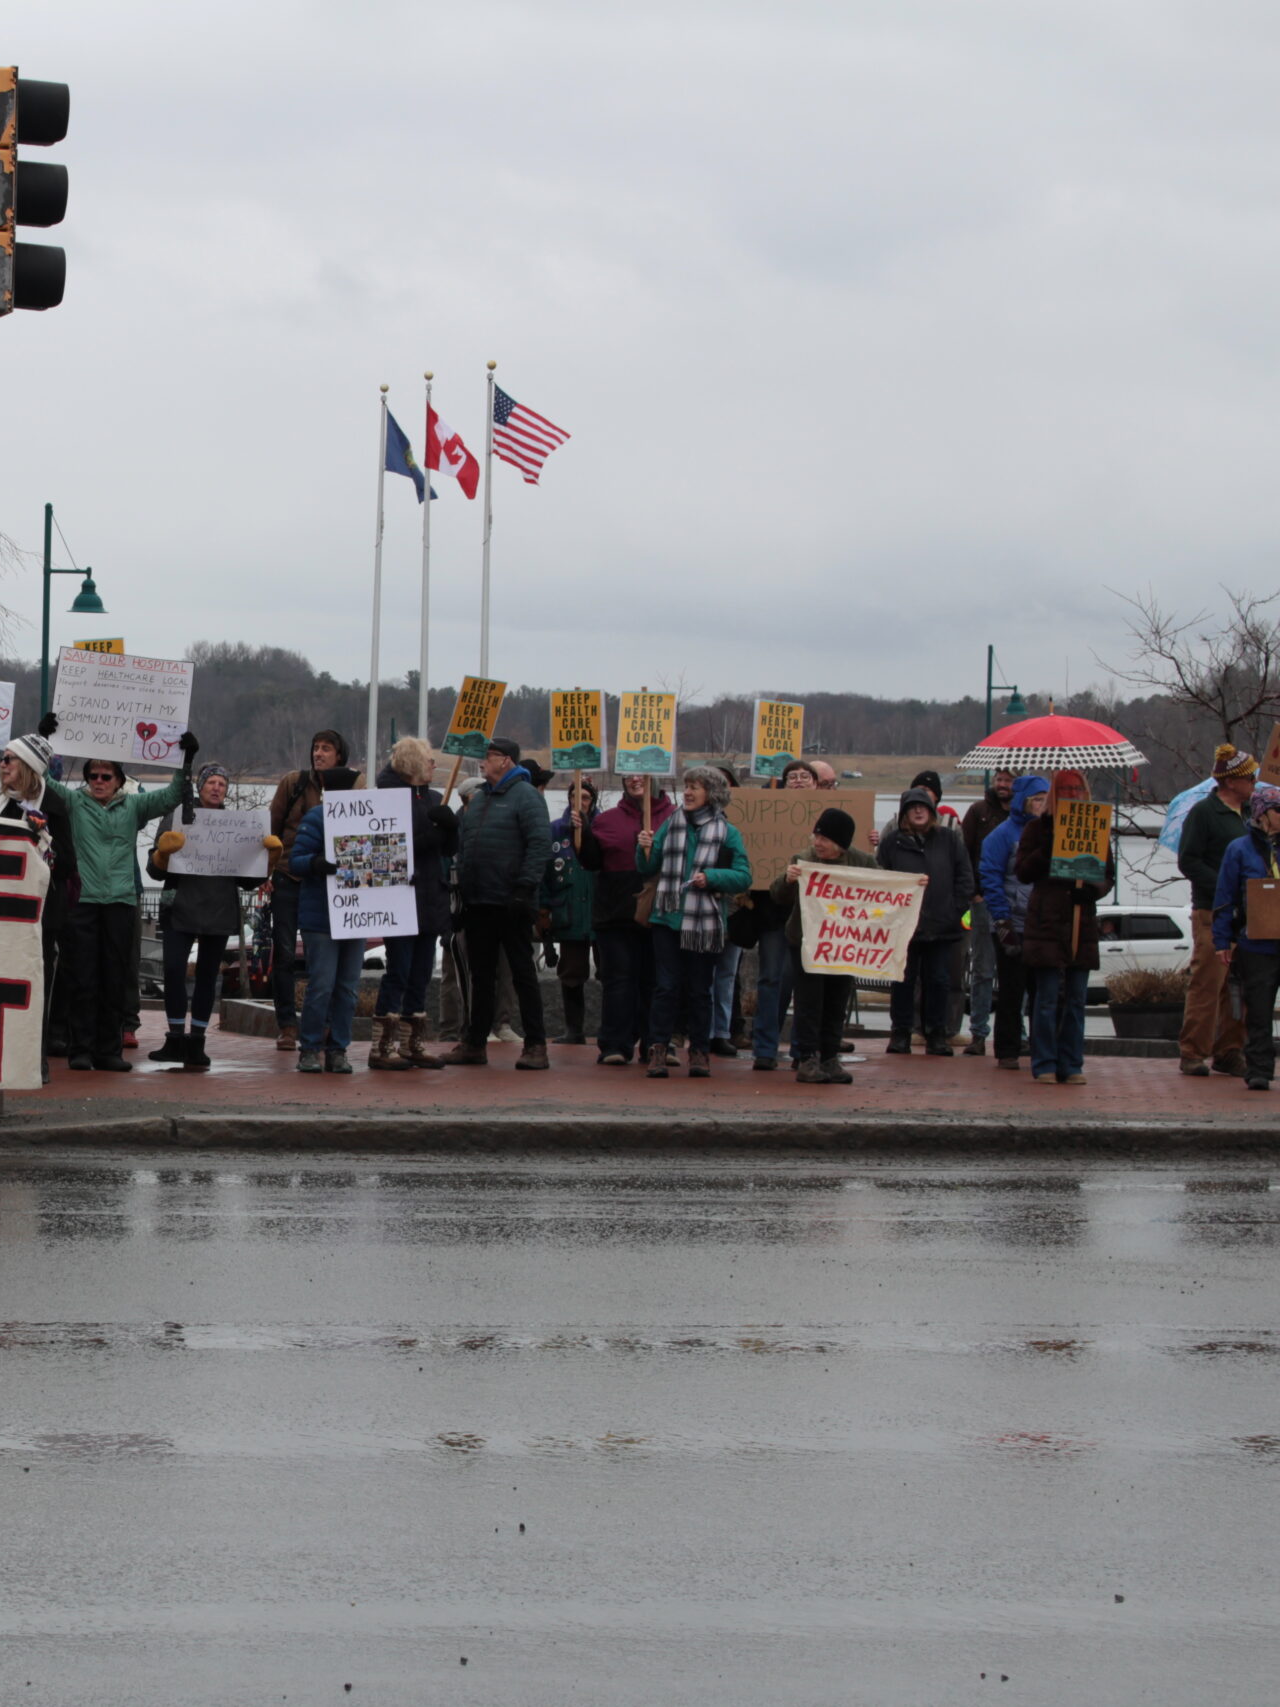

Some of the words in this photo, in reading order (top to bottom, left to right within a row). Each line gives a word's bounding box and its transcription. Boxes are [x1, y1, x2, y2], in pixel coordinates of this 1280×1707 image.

[84, 641, 112, 653] KEEP
[66, 648, 96, 663] SAVE
[99, 654, 126, 666] OUR
[132, 658, 187, 673] HOSPITAL
[62, 664, 87, 675] KEEP
[98, 670, 155, 683] HEALTHCARE
[162, 677, 189, 687] LOCAL
[471, 680, 496, 693] KEEP
[56, 694, 62, 706] I
[68, 696, 110, 710] STAND
[116, 700, 152, 714] WITH
[160, 704, 178, 716] MY
[460, 691, 500, 708] HEALTH
[562, 693, 590, 704] KEEP
[633, 695, 664, 707] KEEP
[464, 706, 490, 719] CARE
[555, 705, 598, 717] HEALTH
[624, 708, 670, 720] HEALTH
[768, 704, 794, 716] KEEP
[456, 716, 488, 732] LOCAL
[562, 718, 591, 729] CARE
[630, 720, 662, 732] CARE
[761, 715, 800, 729] HEALTH
[64, 728, 84, 742] DO
[559, 730, 594, 742] LOCAL
[626, 732, 664, 745] LOCAL
[766, 728, 792, 740] CARE
[763, 738, 794, 753] LOCAL
[326, 800, 374, 819] HANDS
[1070, 802, 1100, 816] KEEP
[202, 814, 246, 827] deserve
[368, 818, 398, 832] OFF
[1060, 814, 1107, 830] HEALTH
[207, 830, 234, 844] NOT
[1066, 828, 1098, 842] CARE
[1062, 839, 1099, 854] LOCAL
[805, 871, 913, 907] HEALTHCARE
[332, 894, 360, 908] OUR
[841, 906, 856, 920] IS
[858, 908, 868, 920] A
[343, 912, 398, 929] HOSPITAL
[818, 920, 890, 944] HUMAN
[813, 941, 894, 969] RIGHT!
